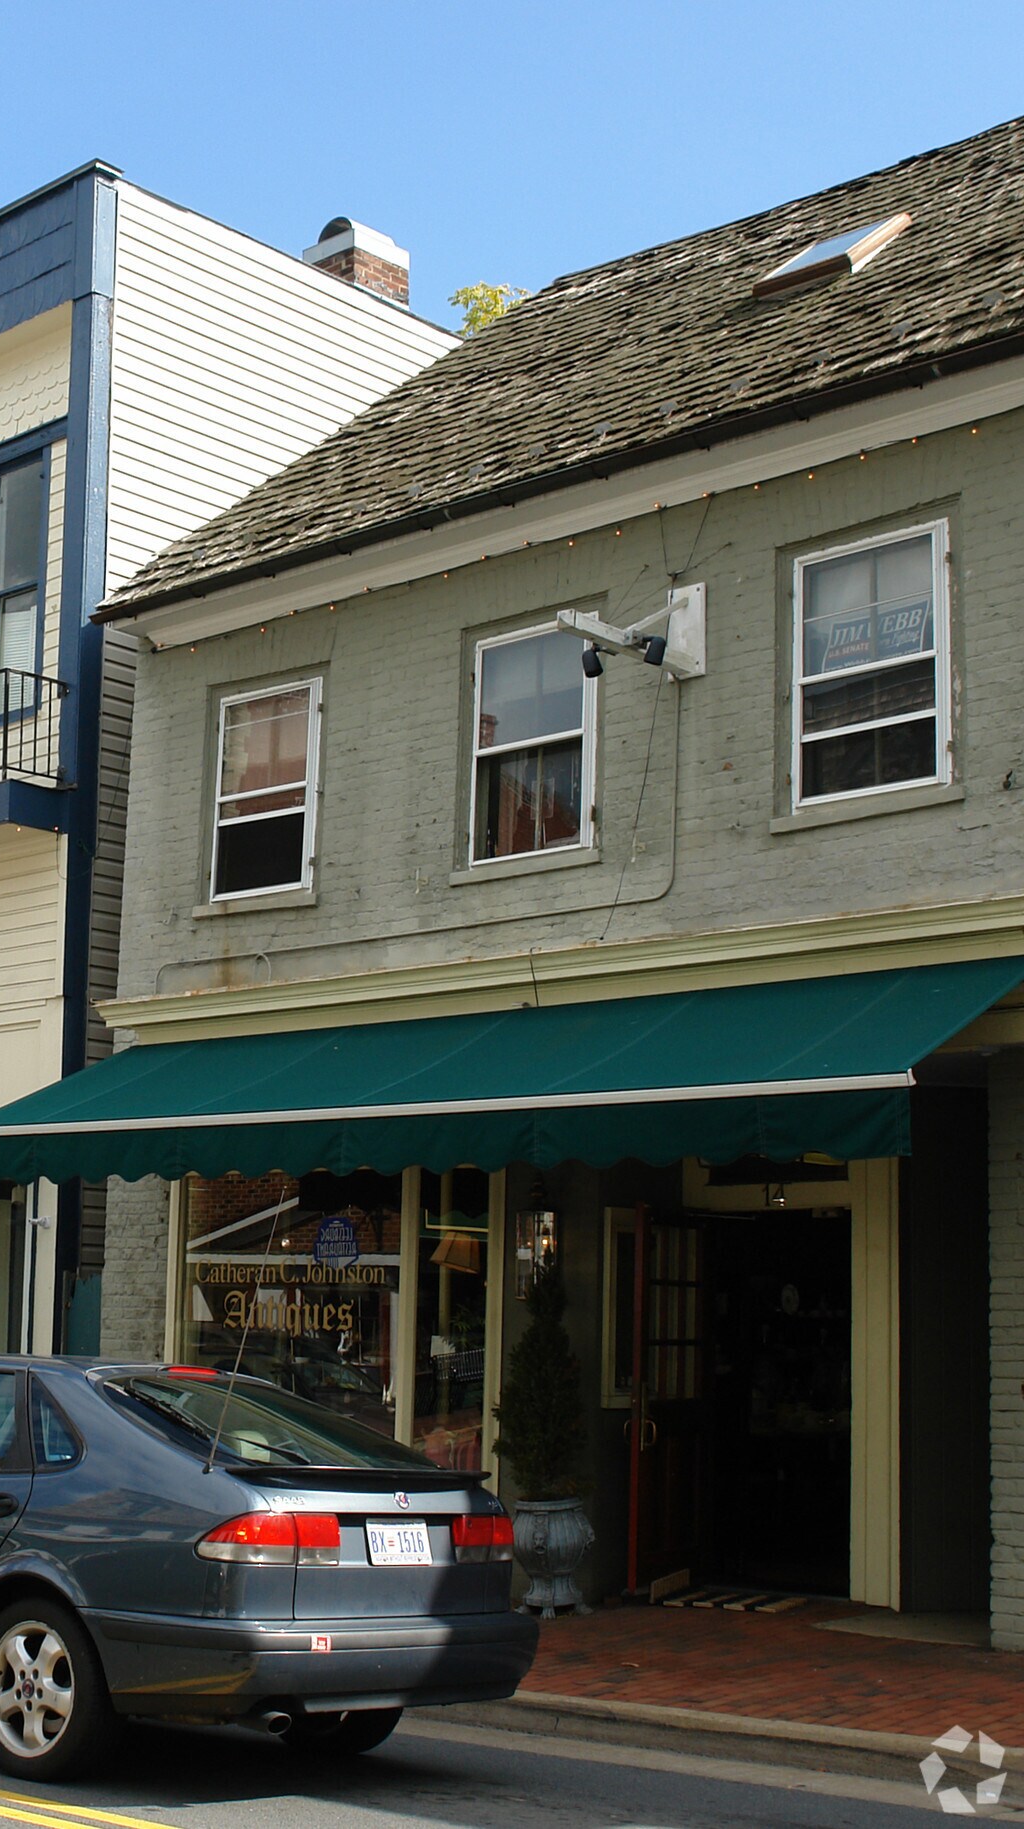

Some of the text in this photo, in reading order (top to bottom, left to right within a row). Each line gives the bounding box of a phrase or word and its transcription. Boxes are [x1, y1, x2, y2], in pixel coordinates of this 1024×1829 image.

[829, 623, 865, 649] JIM
[842, 642, 870, 656] SENATE
[195, 1257, 386, 1285] Catheran C. Johnston
[223, 1290, 355, 1338] Antiques
